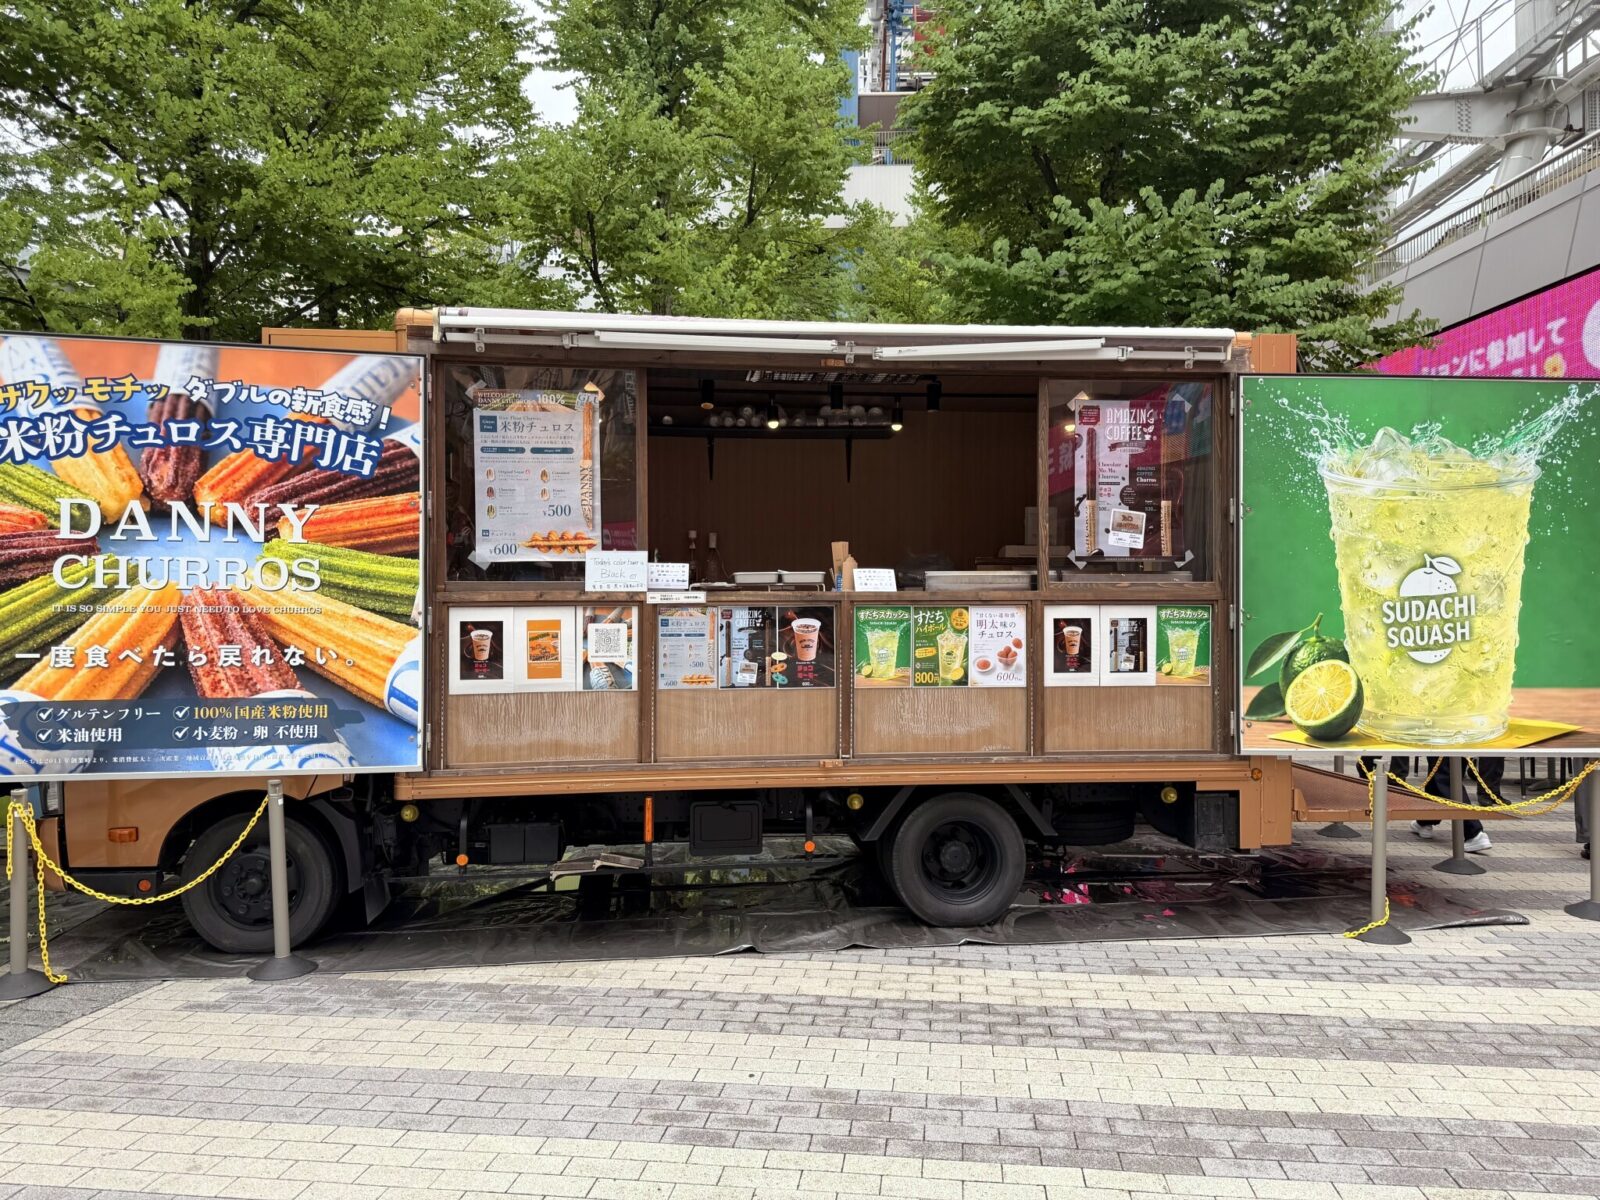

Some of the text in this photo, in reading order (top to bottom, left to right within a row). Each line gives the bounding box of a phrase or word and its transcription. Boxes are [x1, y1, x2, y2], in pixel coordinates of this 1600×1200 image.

[0, 379, 76, 411] ザクッ
[84, 373, 169, 404] モチッ
[536, 393, 566, 405] 100%
[1106, 408, 1155, 424] AMAZING
[500, 420, 575, 433] 米粉チュロス
[1105, 425, 1143, 441] COFFEE
[0, 410, 383, 477] 米粉チュロス専門店
[580, 465, 590, 507] DANNY
[543, 504, 571, 518] ¥500
[55, 498, 320, 543] DANNY
[489, 543, 518, 556] ¥600
[52, 554, 321, 591] CHURROS
[600, 568, 625, 579] Black
[51, 604, 323, 615] IT IS SO SIMPLE YOU JUST NEED TO LOVE CHURROS
[735, 609, 762, 618] AMAZING
[858, 609, 909, 621] すだちスカッシュ
[1160, 609, 1208, 619] すだちスカッシュ
[1382, 594, 1476, 624] SUDACHI
[914, 610, 944, 625] すだち
[976, 619, 1017, 630] 明太味の
[915, 624, 946, 633] ハイボール
[978, 630, 1013, 639] チュロス
[1387, 620, 1470, 648] SQUASH
[15, 644, 357, 668] 一度食べたら戻れない。
[55, 707, 162, 722] グルテンフリー
[193, 704, 329, 721] 100%国産米粉使用
[55, 727, 123, 743] 米油使用
[274, 724, 319, 740] 不使用
